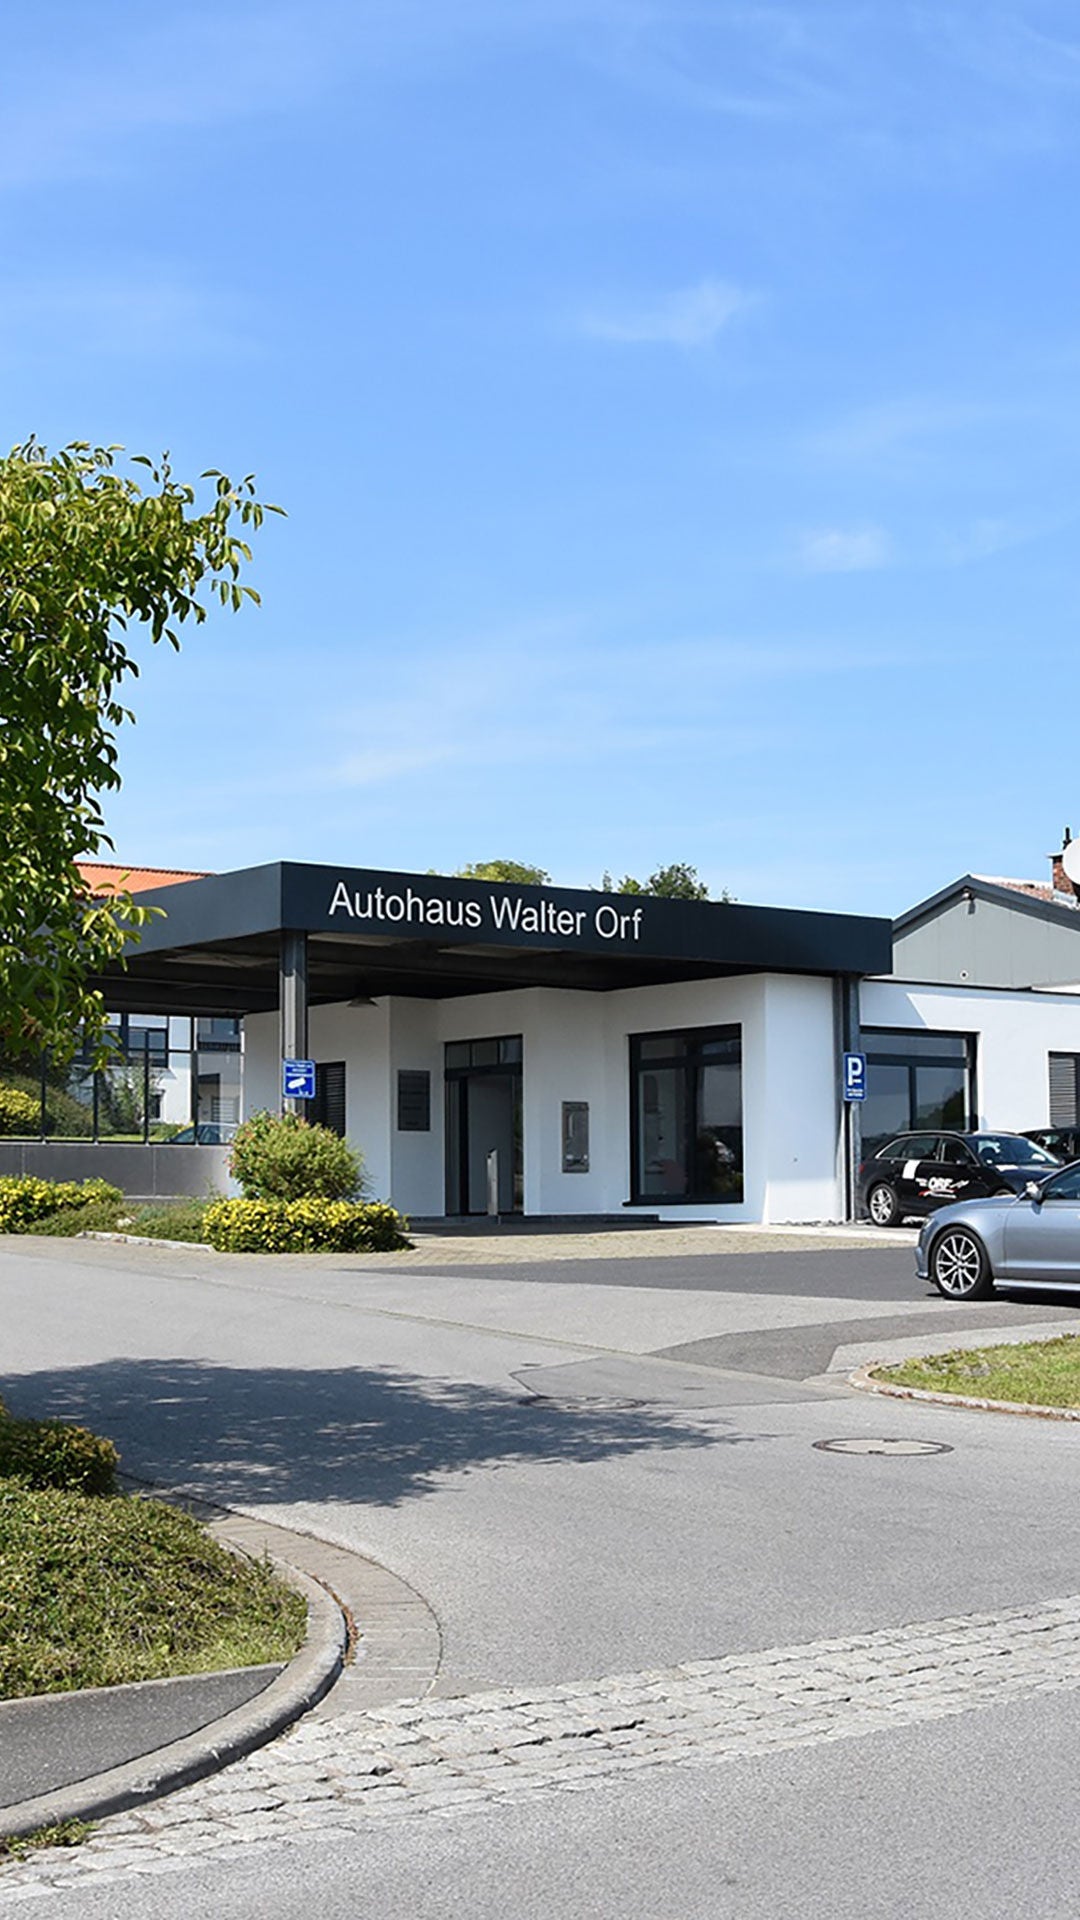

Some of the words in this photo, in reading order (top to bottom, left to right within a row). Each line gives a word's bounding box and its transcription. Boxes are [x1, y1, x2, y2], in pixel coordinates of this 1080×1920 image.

[329, 882, 482, 927] Autohaus
[490, 895, 586, 936] Walter
[595, 905, 643, 940] Orf
[848, 1057, 862, 1086] P
